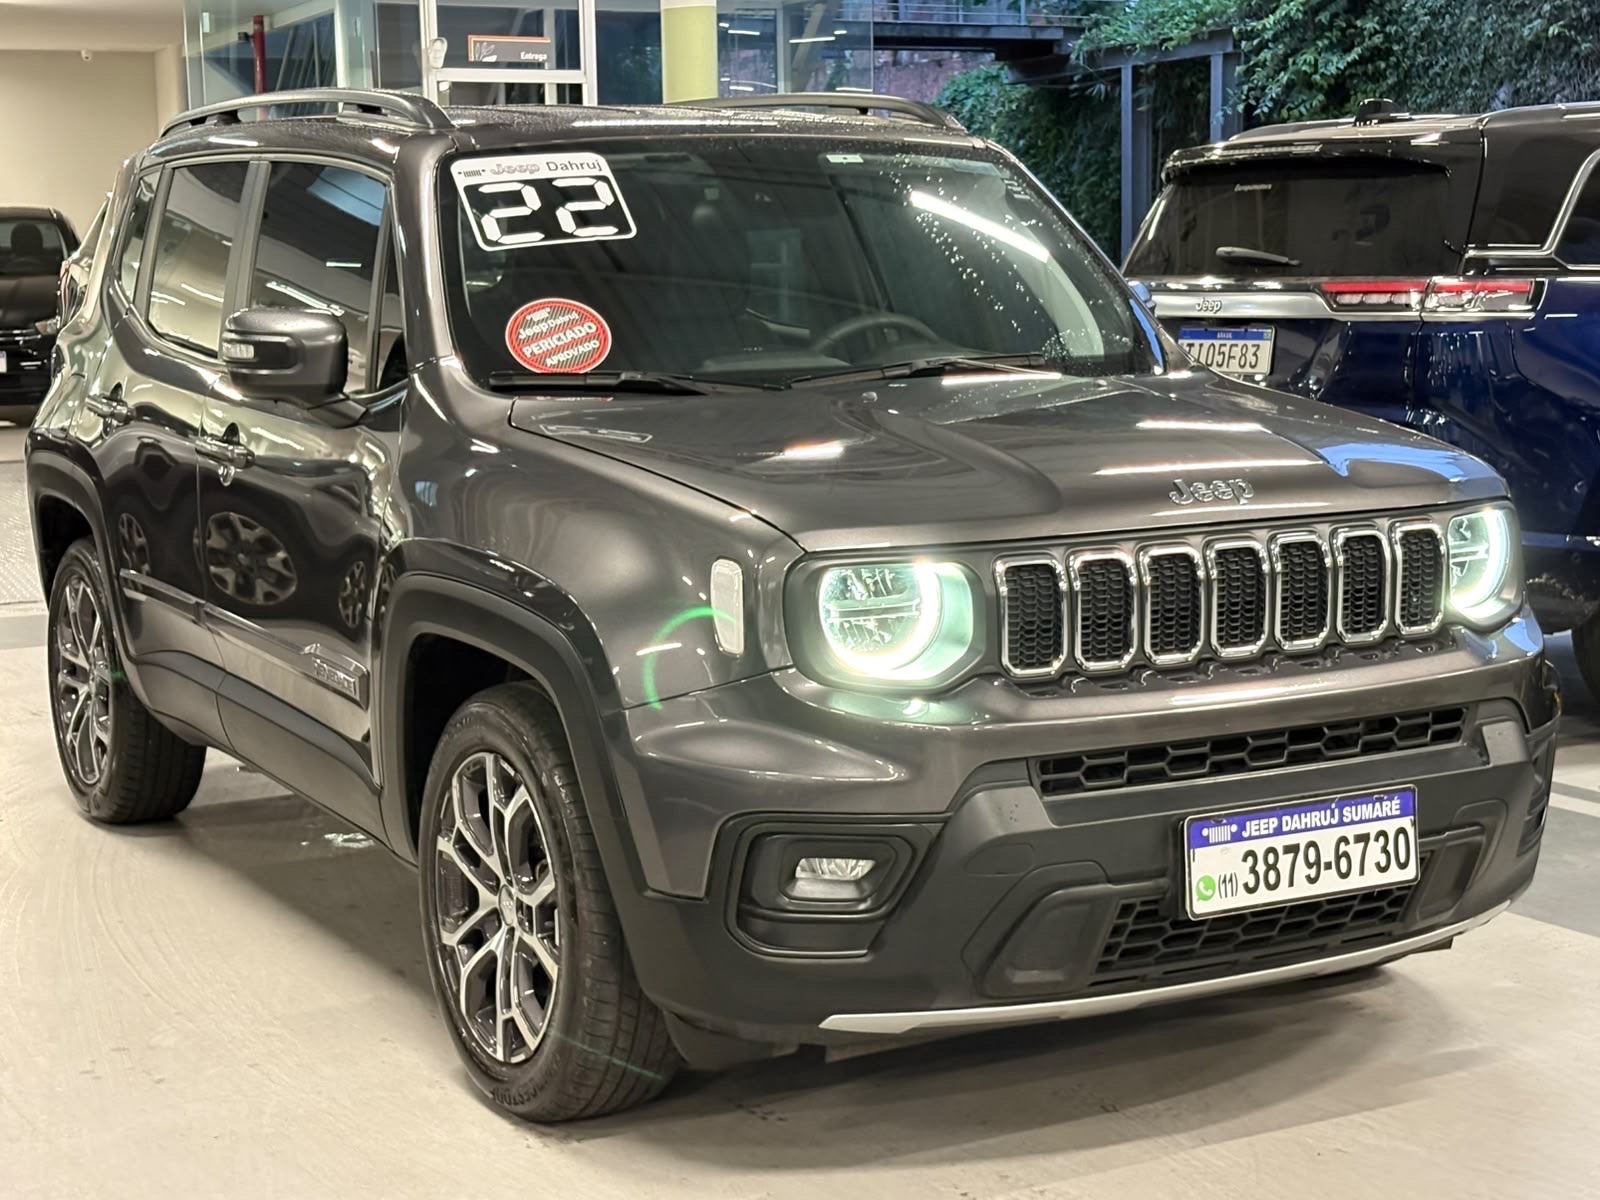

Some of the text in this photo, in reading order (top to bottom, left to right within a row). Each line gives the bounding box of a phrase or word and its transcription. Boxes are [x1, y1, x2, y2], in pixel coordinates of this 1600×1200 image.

[490, 159, 602, 175] Jeep Dahruj
[478, 177, 618, 244] 22
[1195, 298, 1222, 313] Jeep
[518, 323, 549, 340] Jeep
[522, 321, 597, 358] PERICIADO
[545, 339, 600, 367] APROVADO
[1168, 478, 1254, 506] Jeep
[1241, 817, 1279, 838] JEEP
[1342, 796, 1401, 823] SUMARÉ
[1217, 825, 1411, 899] (11) 3879-6730
